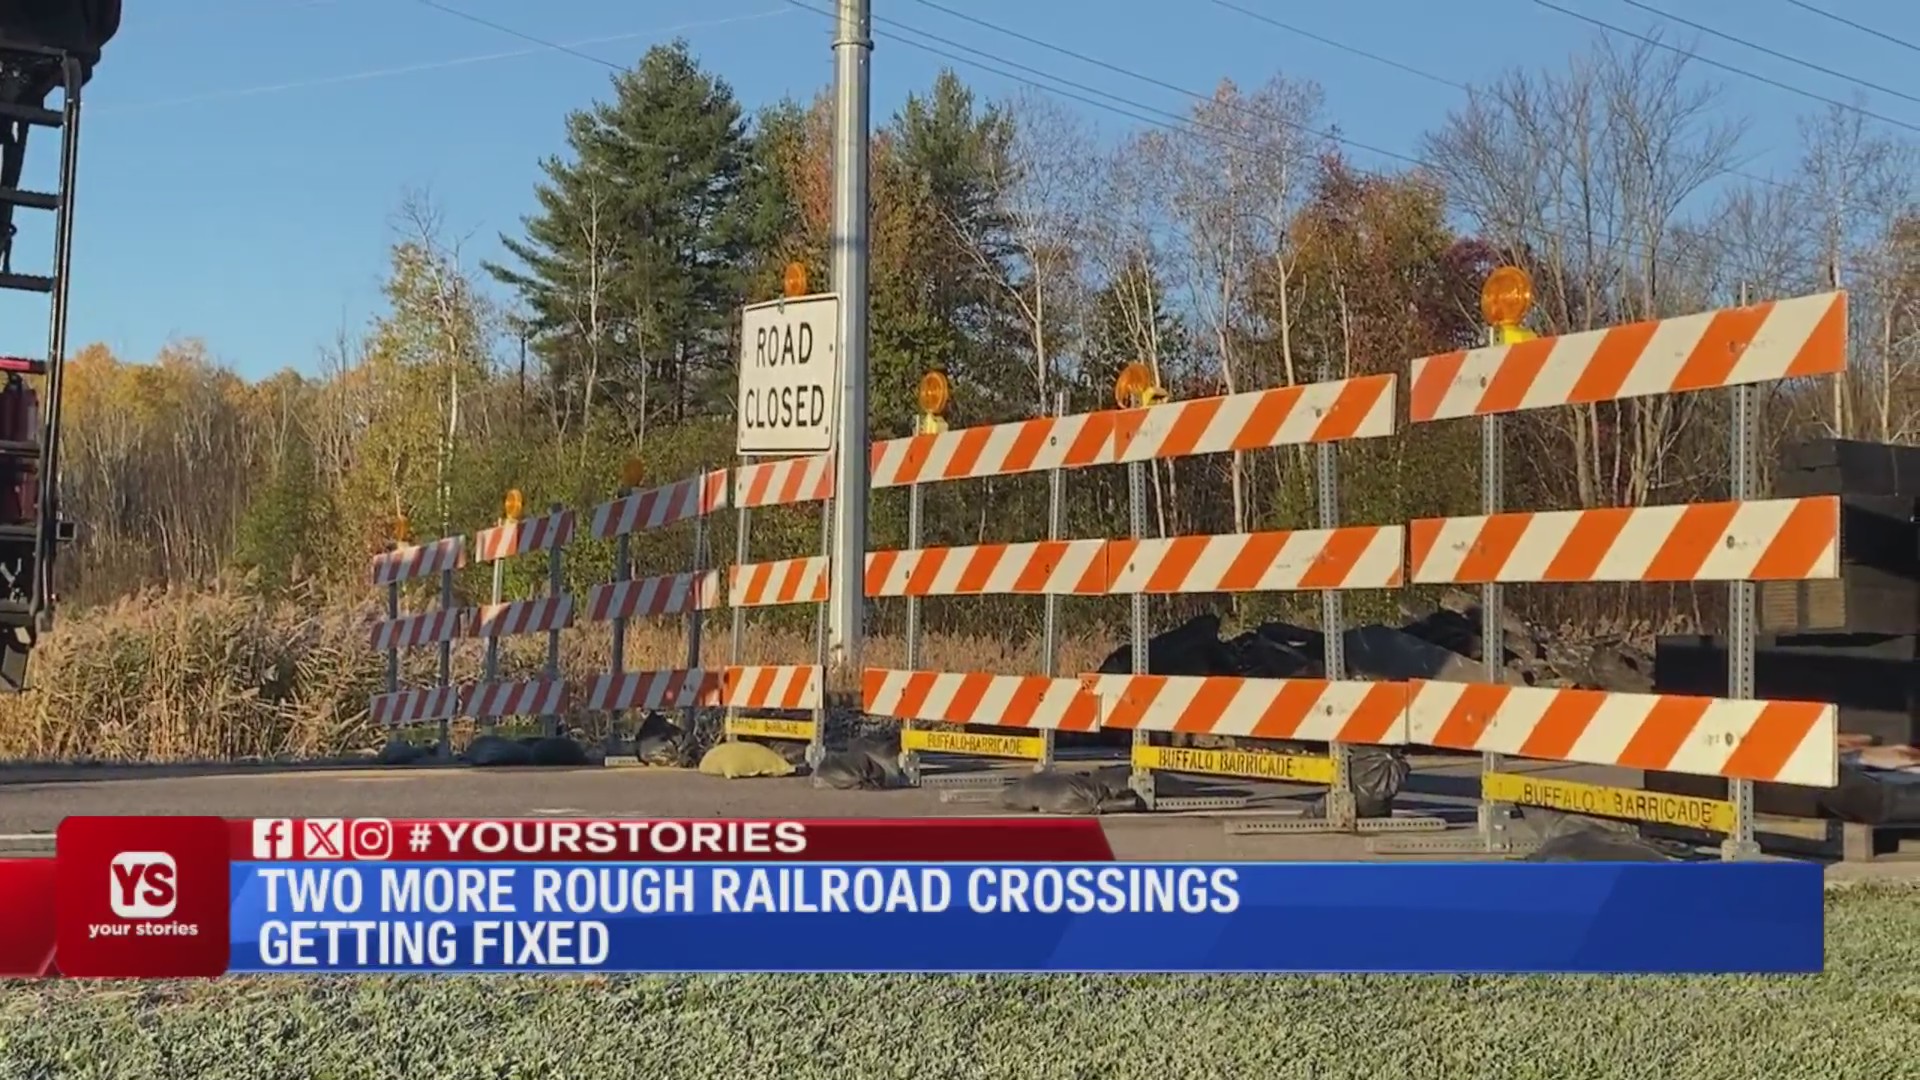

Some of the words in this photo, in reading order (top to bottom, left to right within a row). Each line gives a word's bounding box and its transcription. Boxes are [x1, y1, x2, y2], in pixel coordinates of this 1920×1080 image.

[756, 322, 813, 368] ROAD
[745, 385, 825, 429] CLOSED
[1158, 749, 1214, 770] BUFFALO
[1219, 752, 1294, 777] BARRICADE
[1523, 783, 1595, 811] BUFFALO
[1614, 793, 1712, 823] BARRICADE
